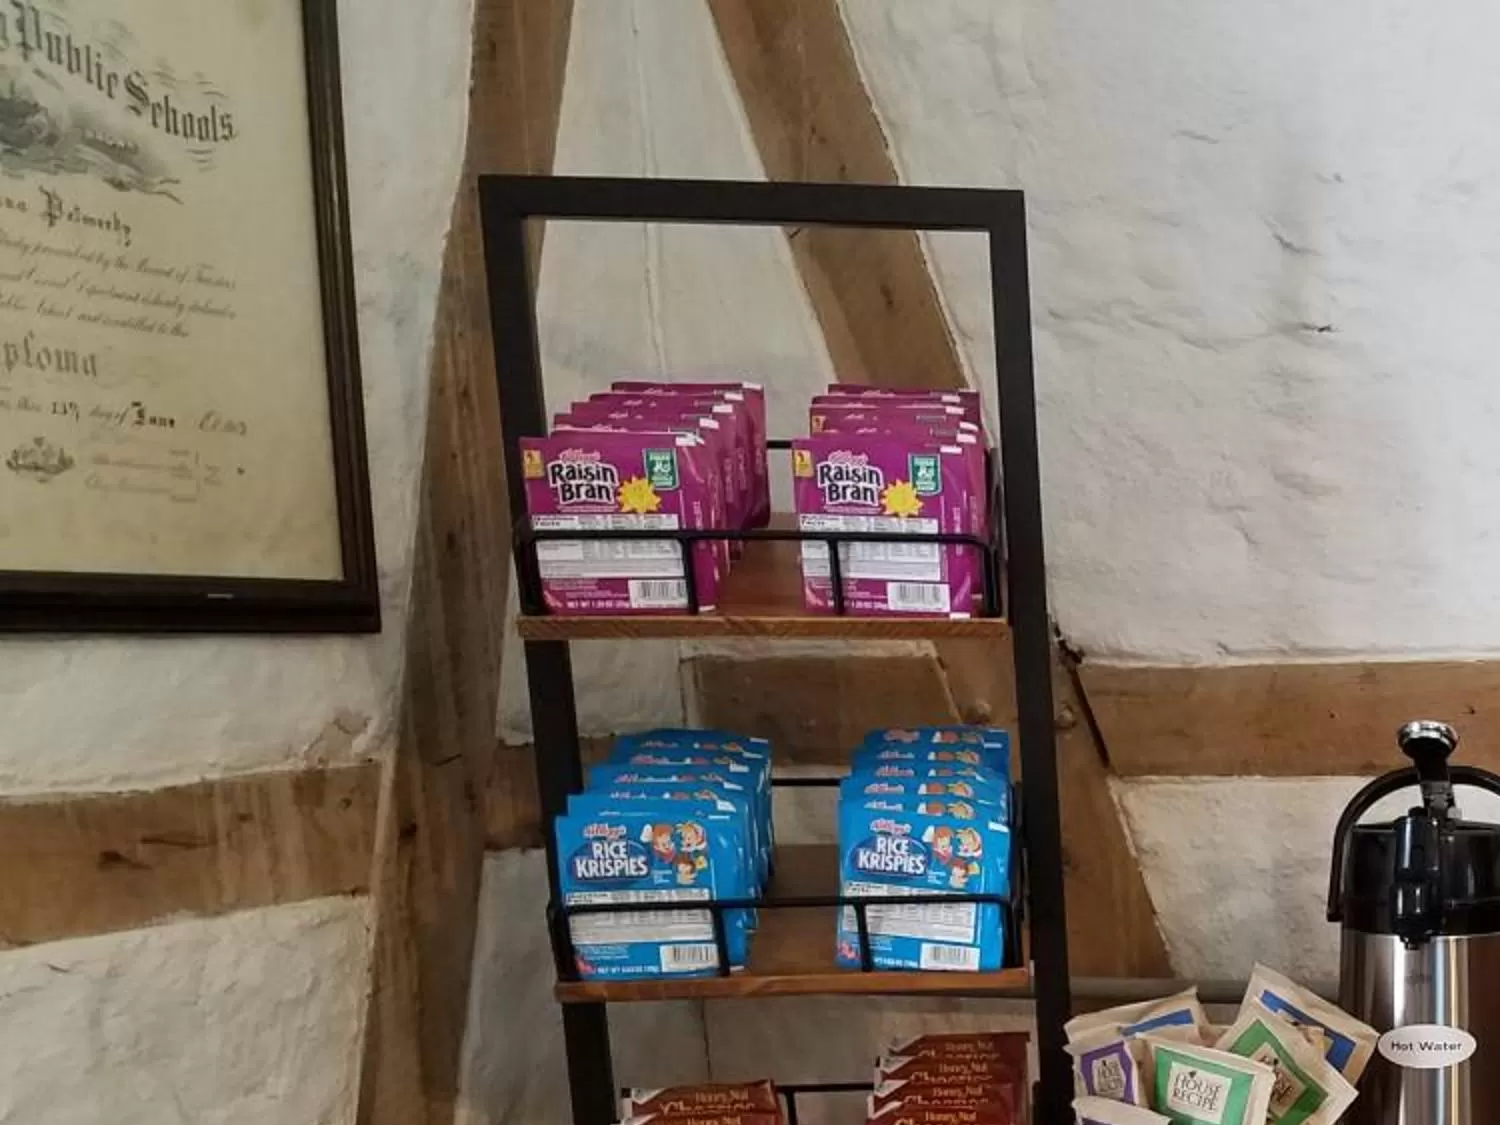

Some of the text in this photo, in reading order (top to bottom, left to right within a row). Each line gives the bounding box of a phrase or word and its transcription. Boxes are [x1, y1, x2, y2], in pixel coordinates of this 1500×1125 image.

[10, 0, 119, 99] Public
[124, 70, 236, 142] Schools
[550, 462, 616, 485] Raisin
[819, 463, 881, 484] Raisin
[560, 483, 612, 503] Bran
[827, 483, 876, 503] Bran
[592, 841, 628, 859] RICE
[876, 836, 909, 854] RICE
[575, 857, 648, 878] KRISPIES
[858, 848, 926, 874] KRISPIES
[1391, 1042, 1462, 1051] Hot Water
[1173, 1071, 1223, 1100] HOUSE
[1172, 1087, 1218, 1111] RECIPE
